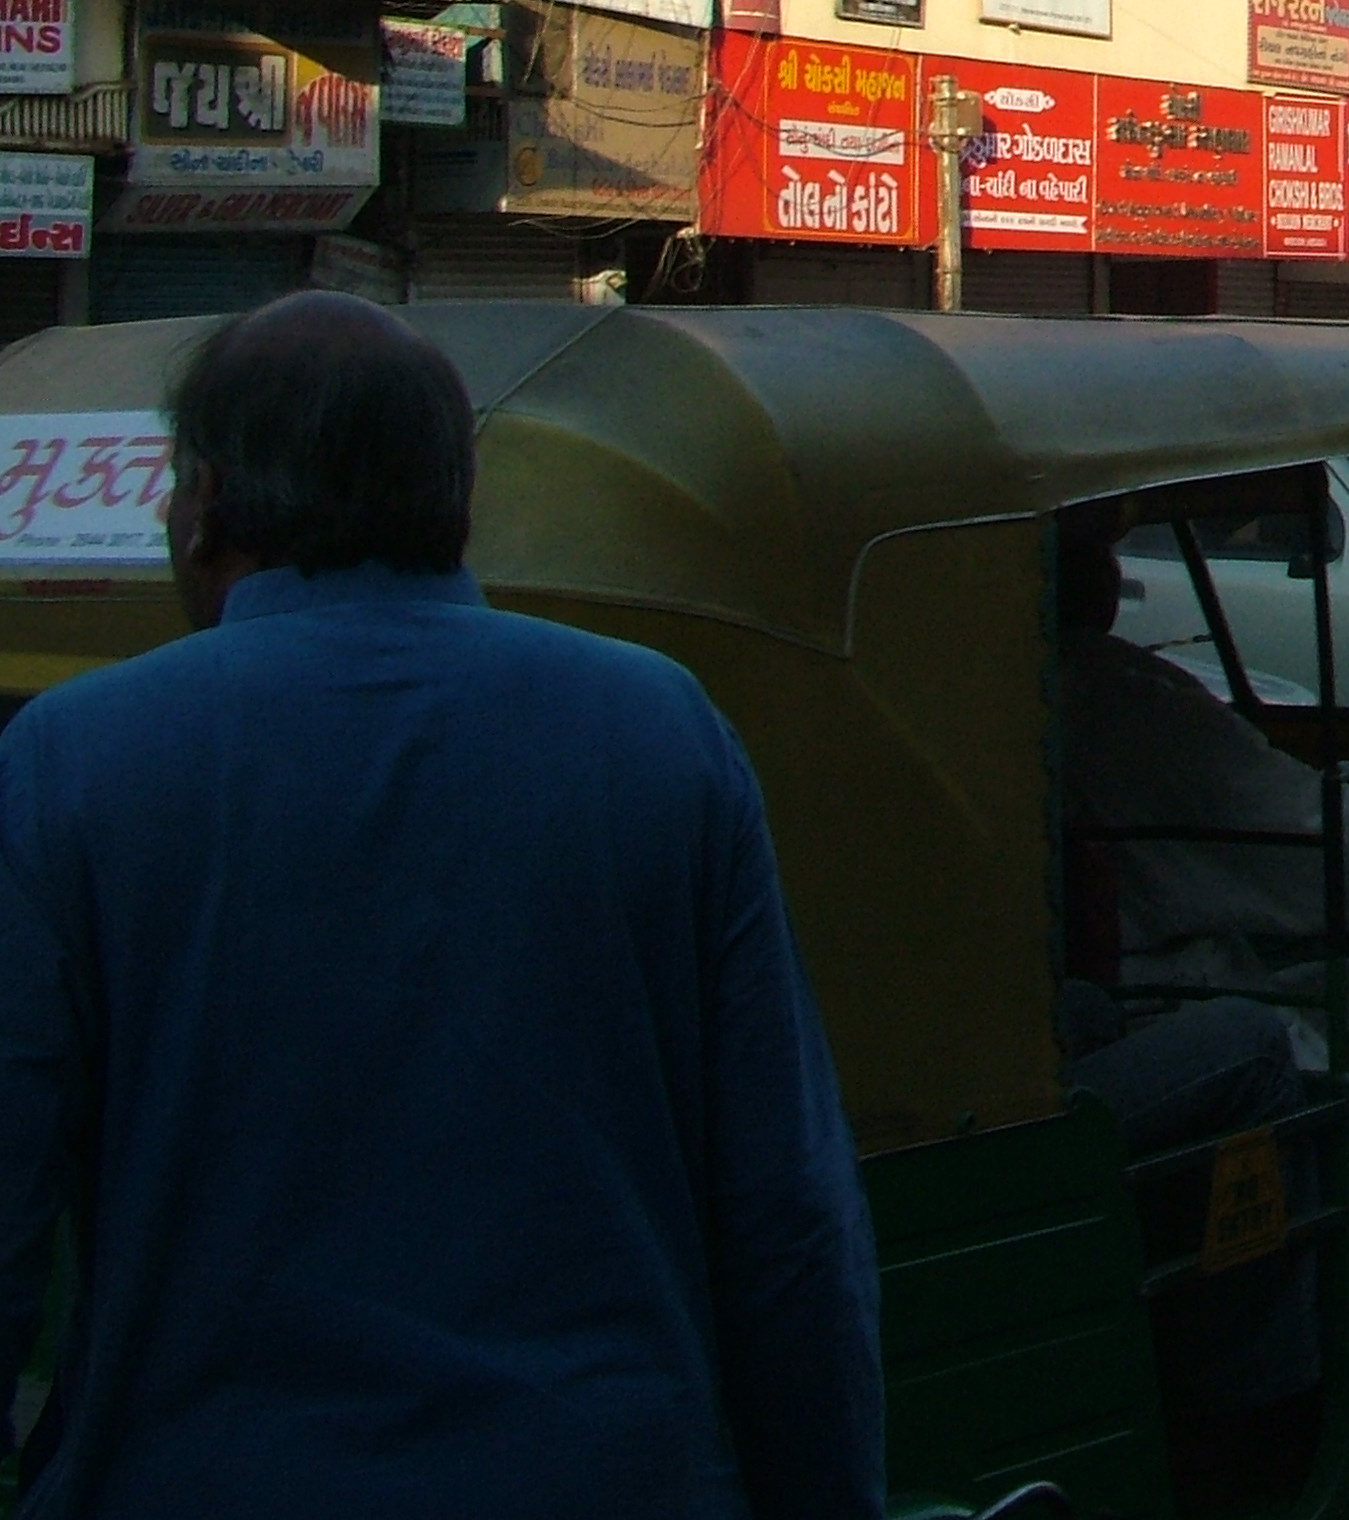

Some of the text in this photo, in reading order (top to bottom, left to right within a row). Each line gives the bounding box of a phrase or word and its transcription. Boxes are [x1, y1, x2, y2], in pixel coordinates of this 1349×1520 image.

[778, 49, 906, 101] શ્રી ચોકસી મહાજન
[961, 170, 1016, 199] ના-ચાંદી
[1310, 181, 1317, 209] &
